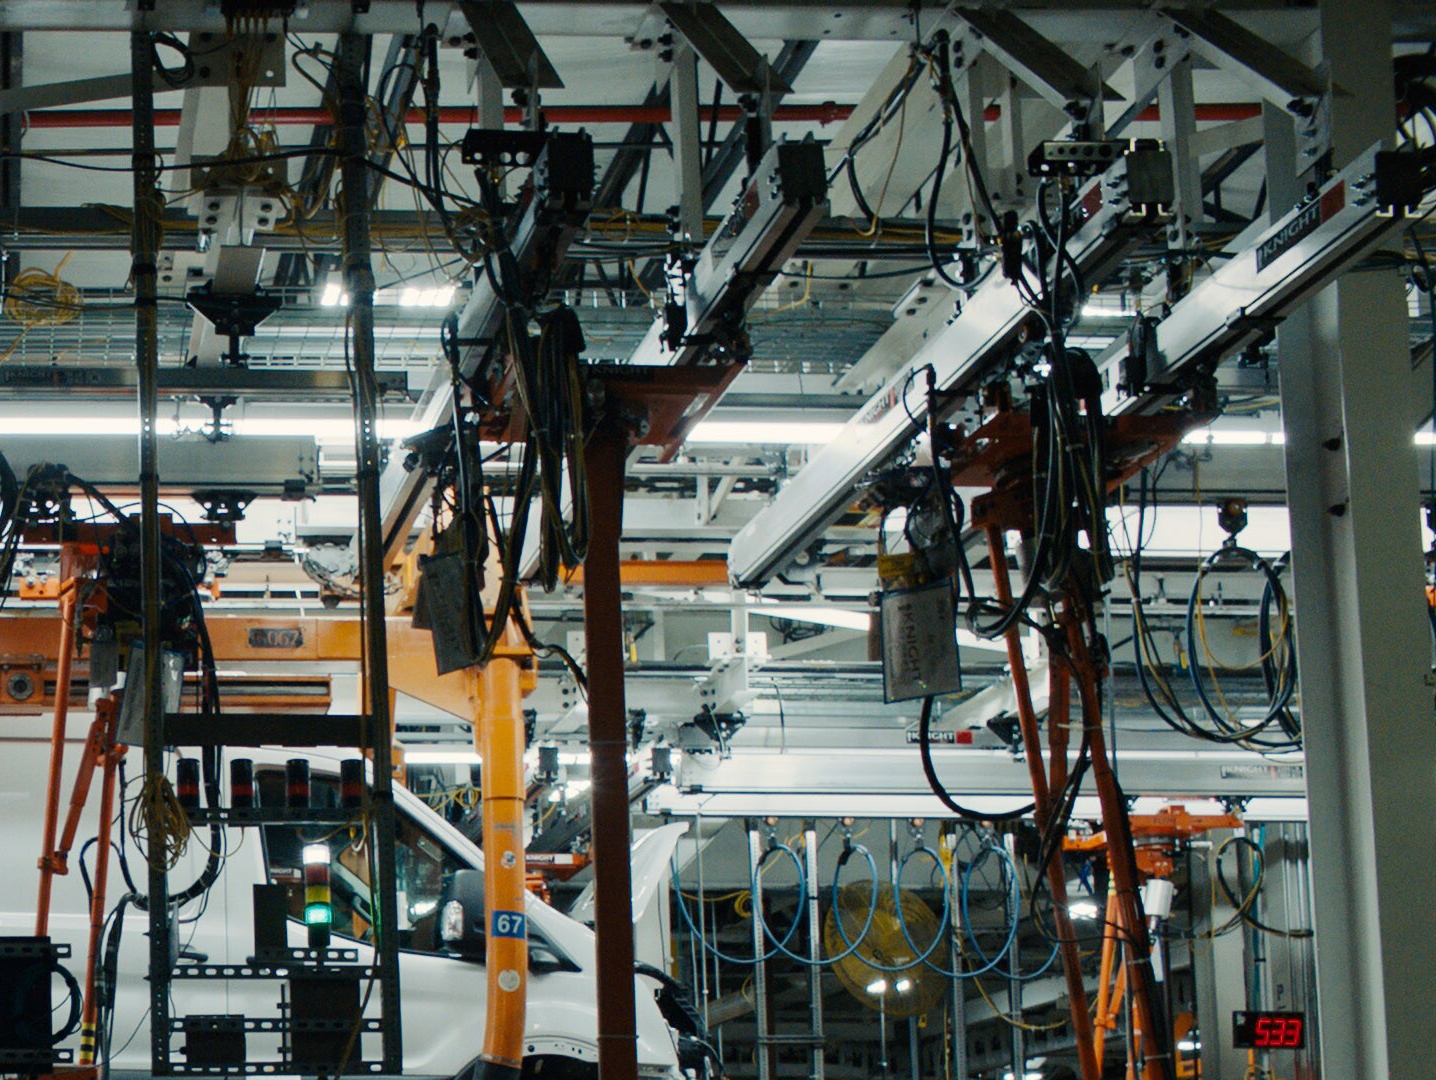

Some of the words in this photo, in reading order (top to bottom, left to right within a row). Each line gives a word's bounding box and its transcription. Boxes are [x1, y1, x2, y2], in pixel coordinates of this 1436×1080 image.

[1264, 203, 1319, 258] KNIGHT
[912, 731, 954, 740] KIGHT
[497, 914, 523, 934] 67
[1255, 1018, 1303, 1046] 533
